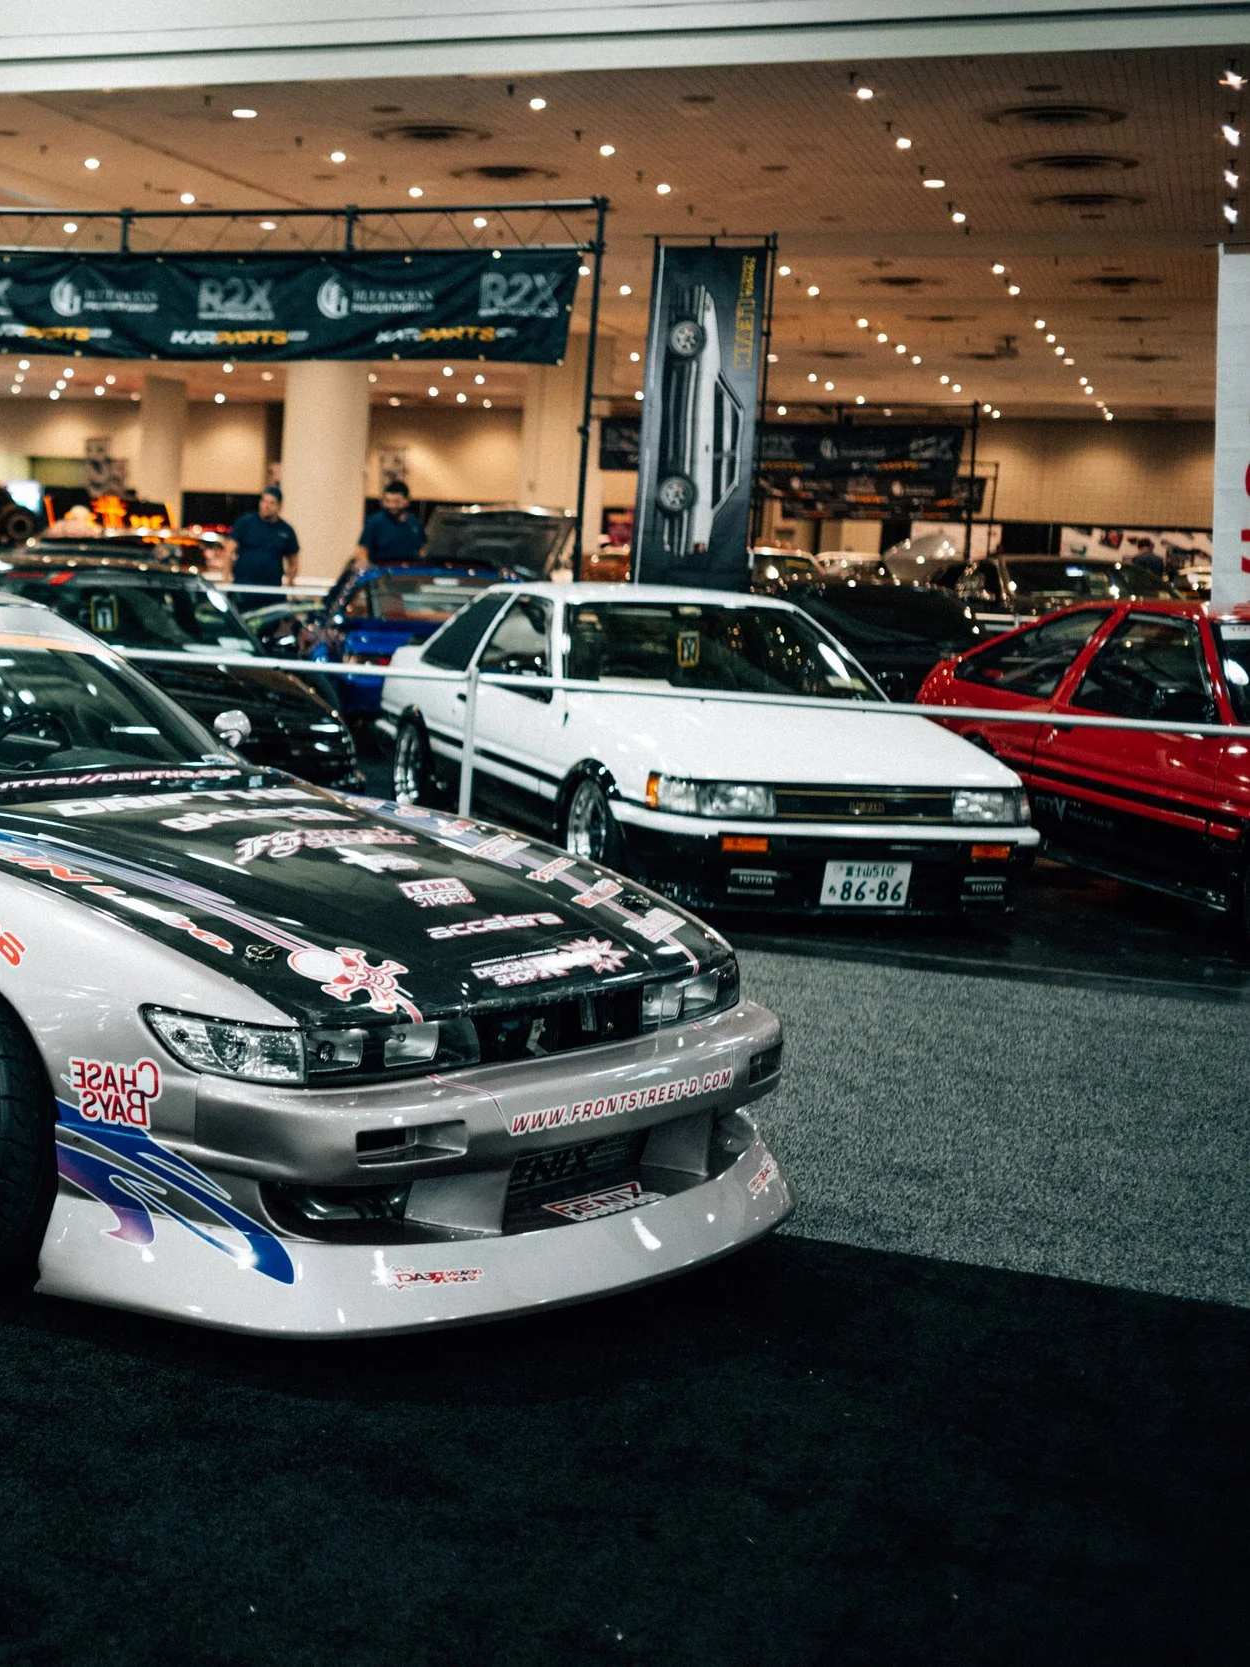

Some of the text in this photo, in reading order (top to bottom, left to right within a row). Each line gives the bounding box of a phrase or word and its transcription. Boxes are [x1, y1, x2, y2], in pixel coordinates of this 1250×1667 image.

[200, 277, 273, 312] R2X
[479, 271, 563, 309] R2X
[738, 876, 773, 885] TOYOTA
[840, 880, 903, 902] 86-86
[970, 883, 1004, 893] TOYOTA
[426, 912, 565, 940] accelera
[511, 1068, 734, 1136] WWW.FRONTSTREET-D.COM
[544, 1181, 644, 1218] FENIX
